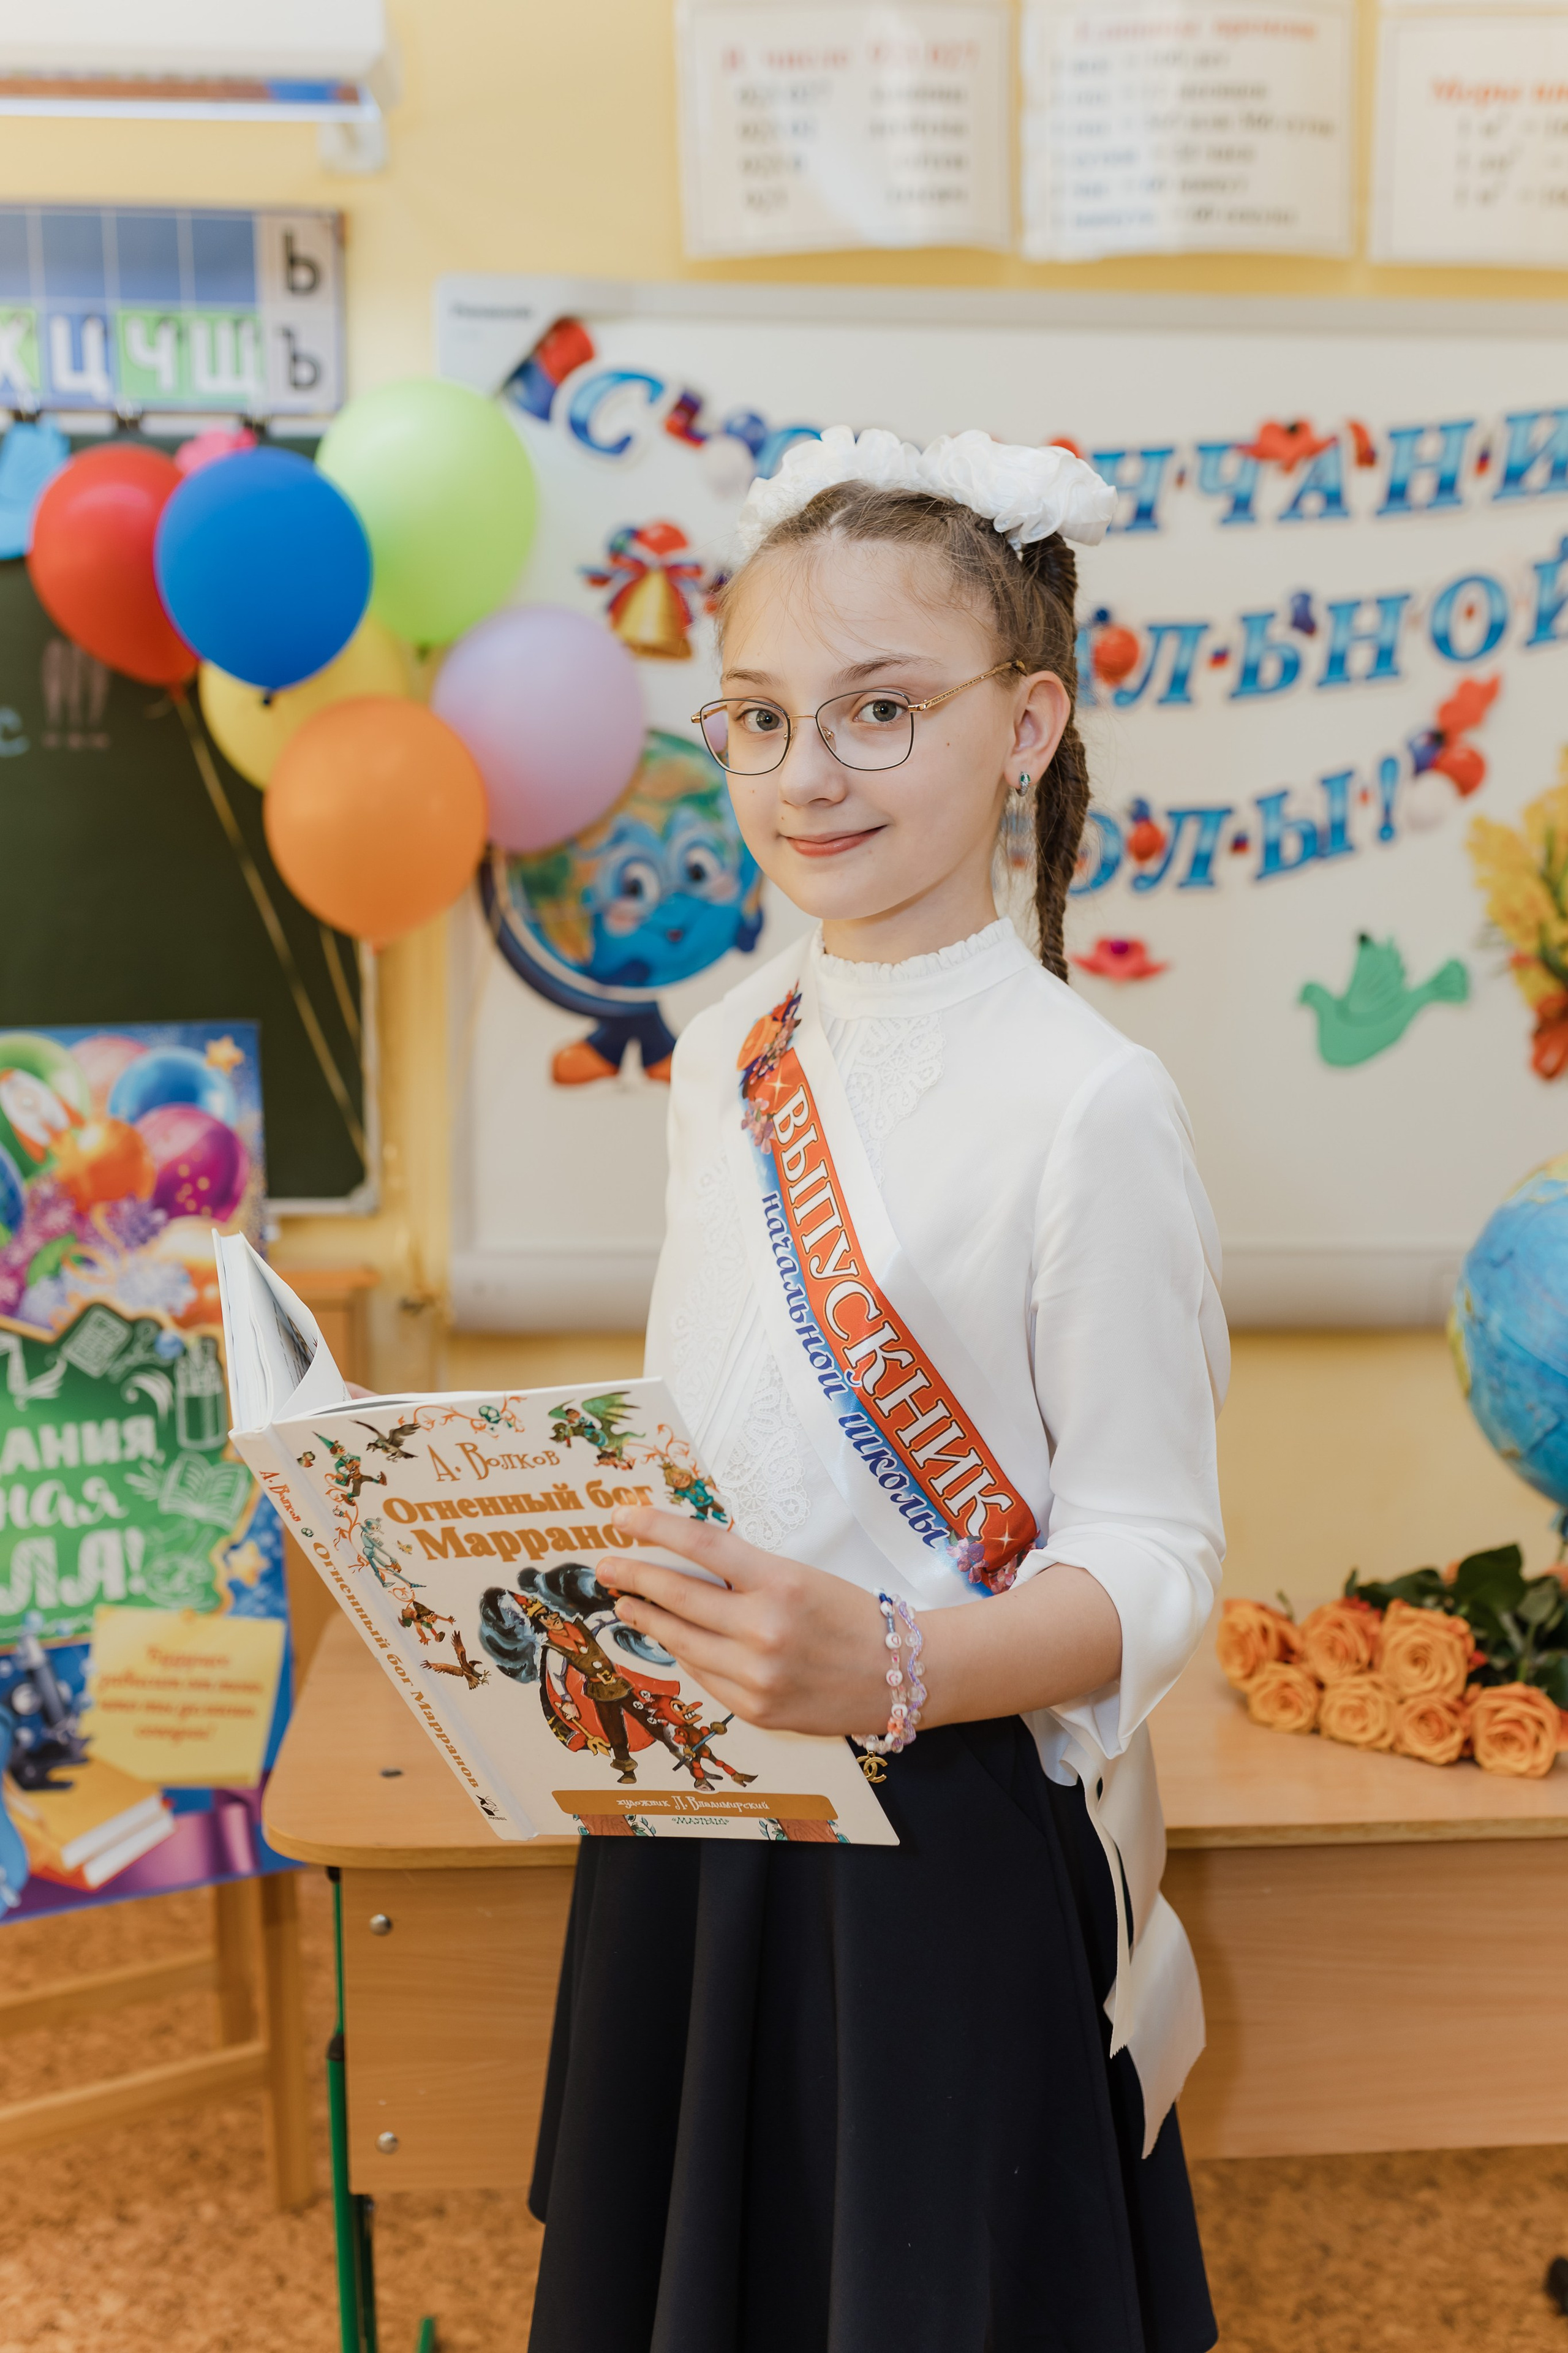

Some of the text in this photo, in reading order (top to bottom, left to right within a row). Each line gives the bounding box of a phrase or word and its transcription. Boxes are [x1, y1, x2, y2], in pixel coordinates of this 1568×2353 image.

[50, 315, 110, 401] Ц
[124, 317, 179, 394] Ч
[772, 1084, 1015, 1543] ВЫПУСКНИК
[762, 1192, 950, 1550] начальной школы
[382, 1479, 654, 1525] Огненный бог
[428, 1444, 461, 1482] А.
[410, 1523, 663, 1563] Маррано
[312, 1541, 479, 1788] Огненный бог Марранов
